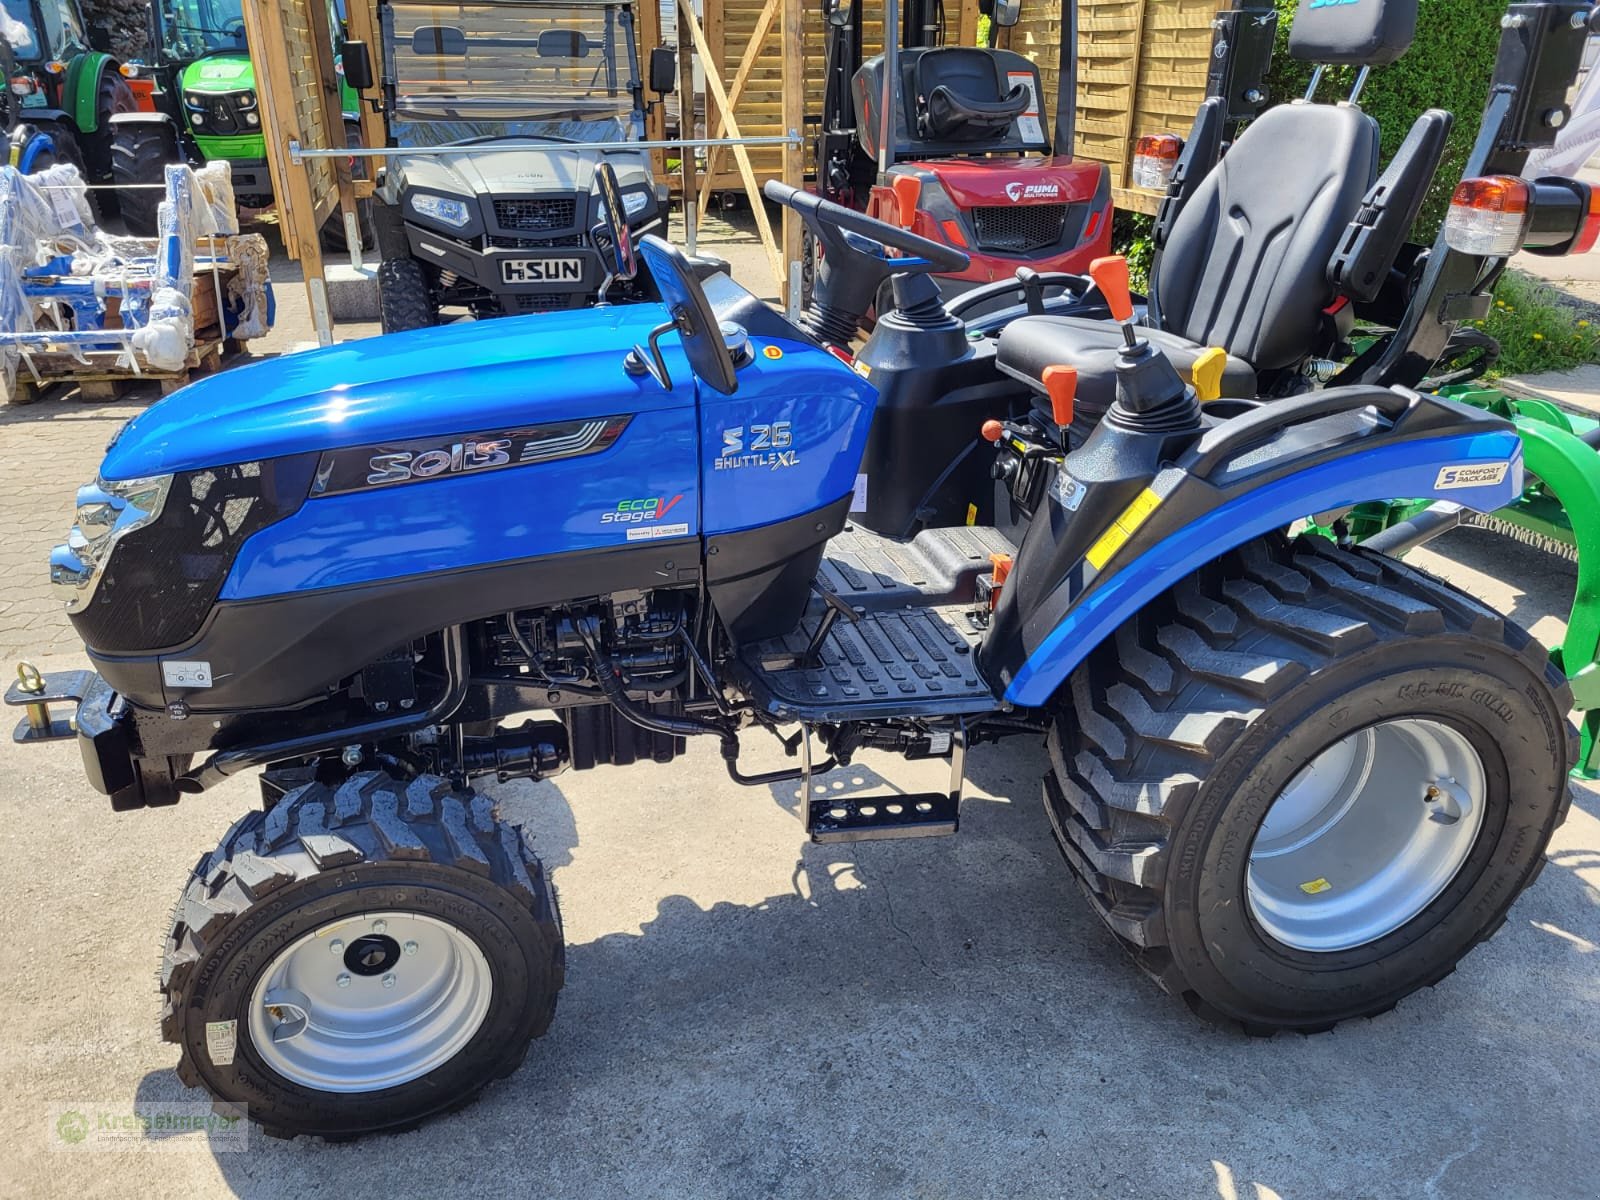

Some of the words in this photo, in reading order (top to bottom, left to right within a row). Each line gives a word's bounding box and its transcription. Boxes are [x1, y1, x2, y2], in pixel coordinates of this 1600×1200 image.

[1024, 184, 1058, 193] PUMA
[722, 426, 744, 457] S
[750, 421, 792, 451] 26
[1459, 467, 1501, 476] COMFORT
[1457, 474, 1498, 483] PACKAGE
[618, 498, 659, 511] ECO
[655, 494, 684, 519] V
[199, 955, 221, 987] SKID
[215, 918, 254, 957] POWER
